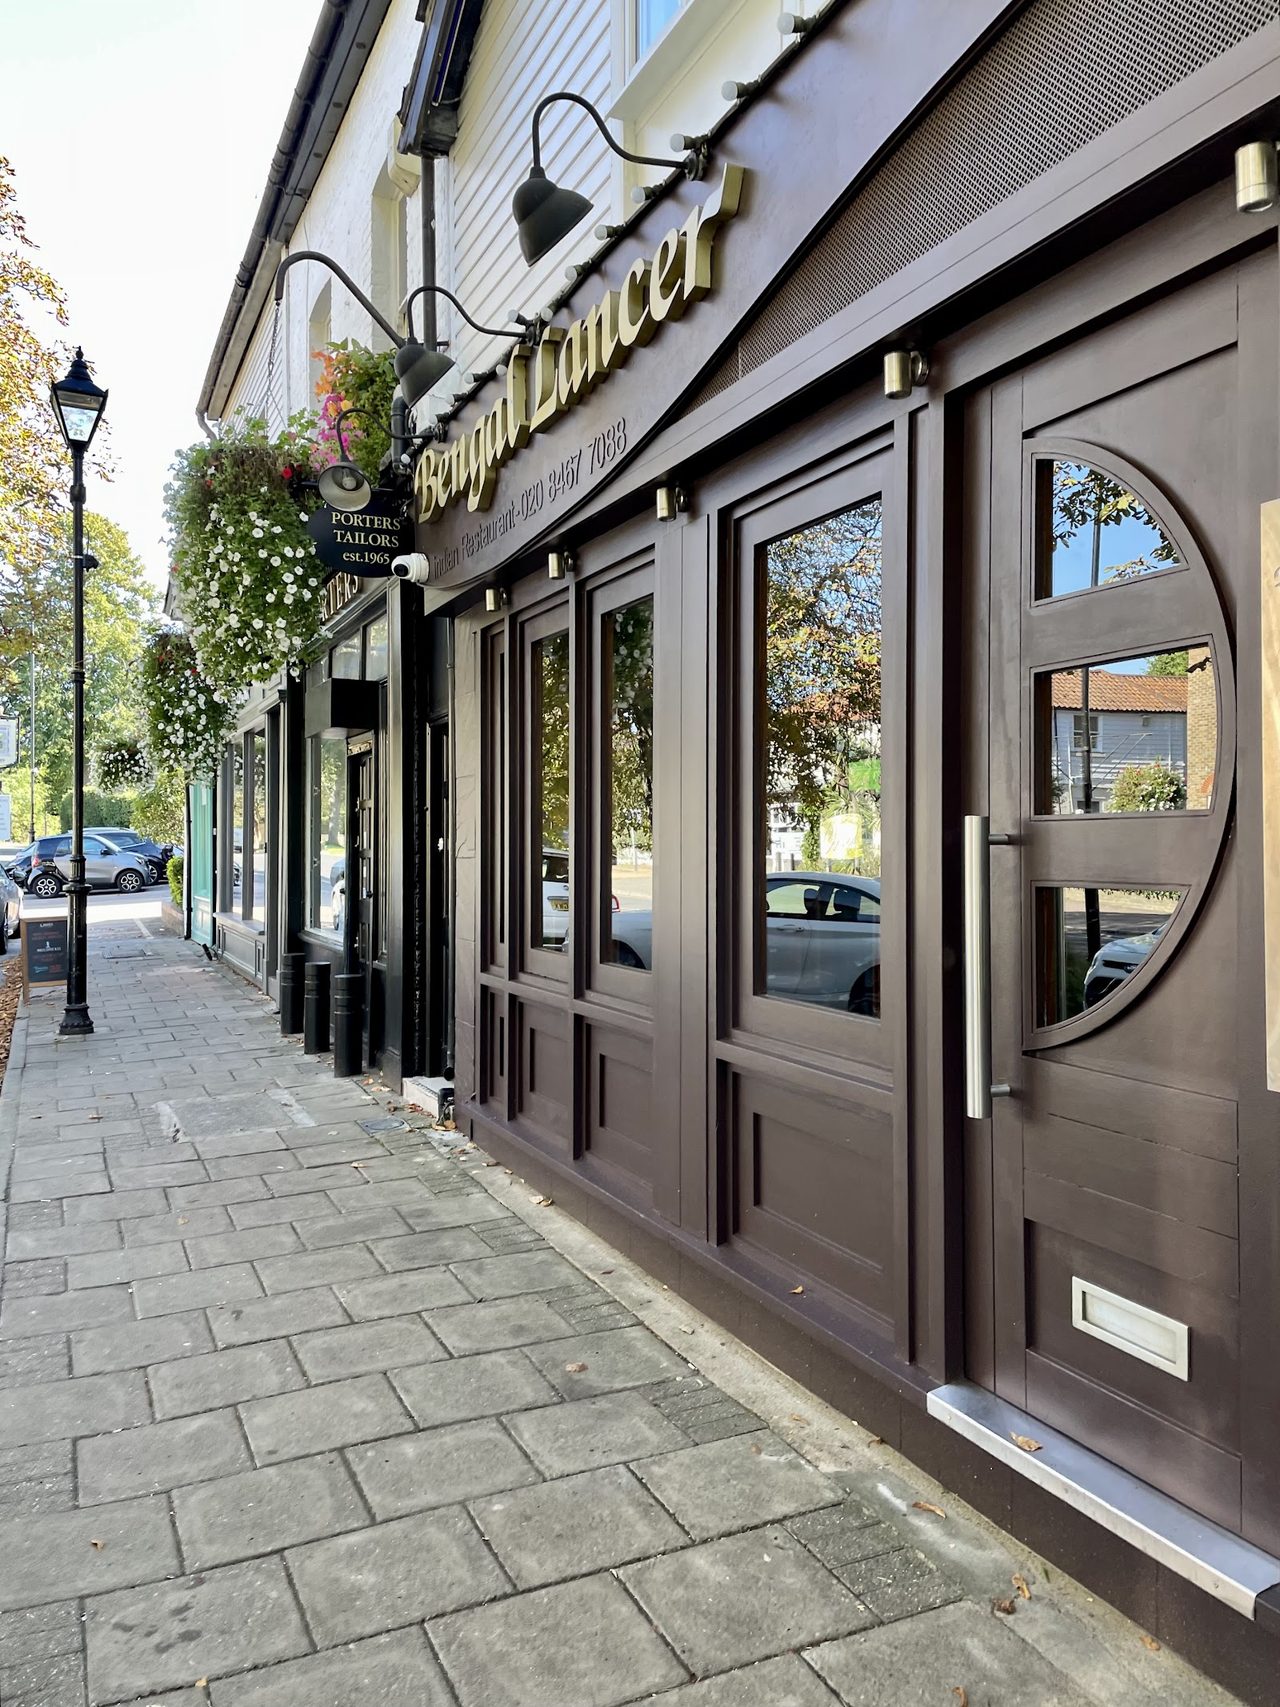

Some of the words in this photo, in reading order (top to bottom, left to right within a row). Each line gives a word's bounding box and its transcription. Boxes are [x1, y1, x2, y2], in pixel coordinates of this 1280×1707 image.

[414, 344, 531, 524] Bengal
[529, 162, 745, 434] Lancer
[548, 449, 582, 503] 8467
[587, 416, 627, 476] 7088
[331, 511, 401, 531] PORTERS
[333, 529, 399, 548] TAILORS
